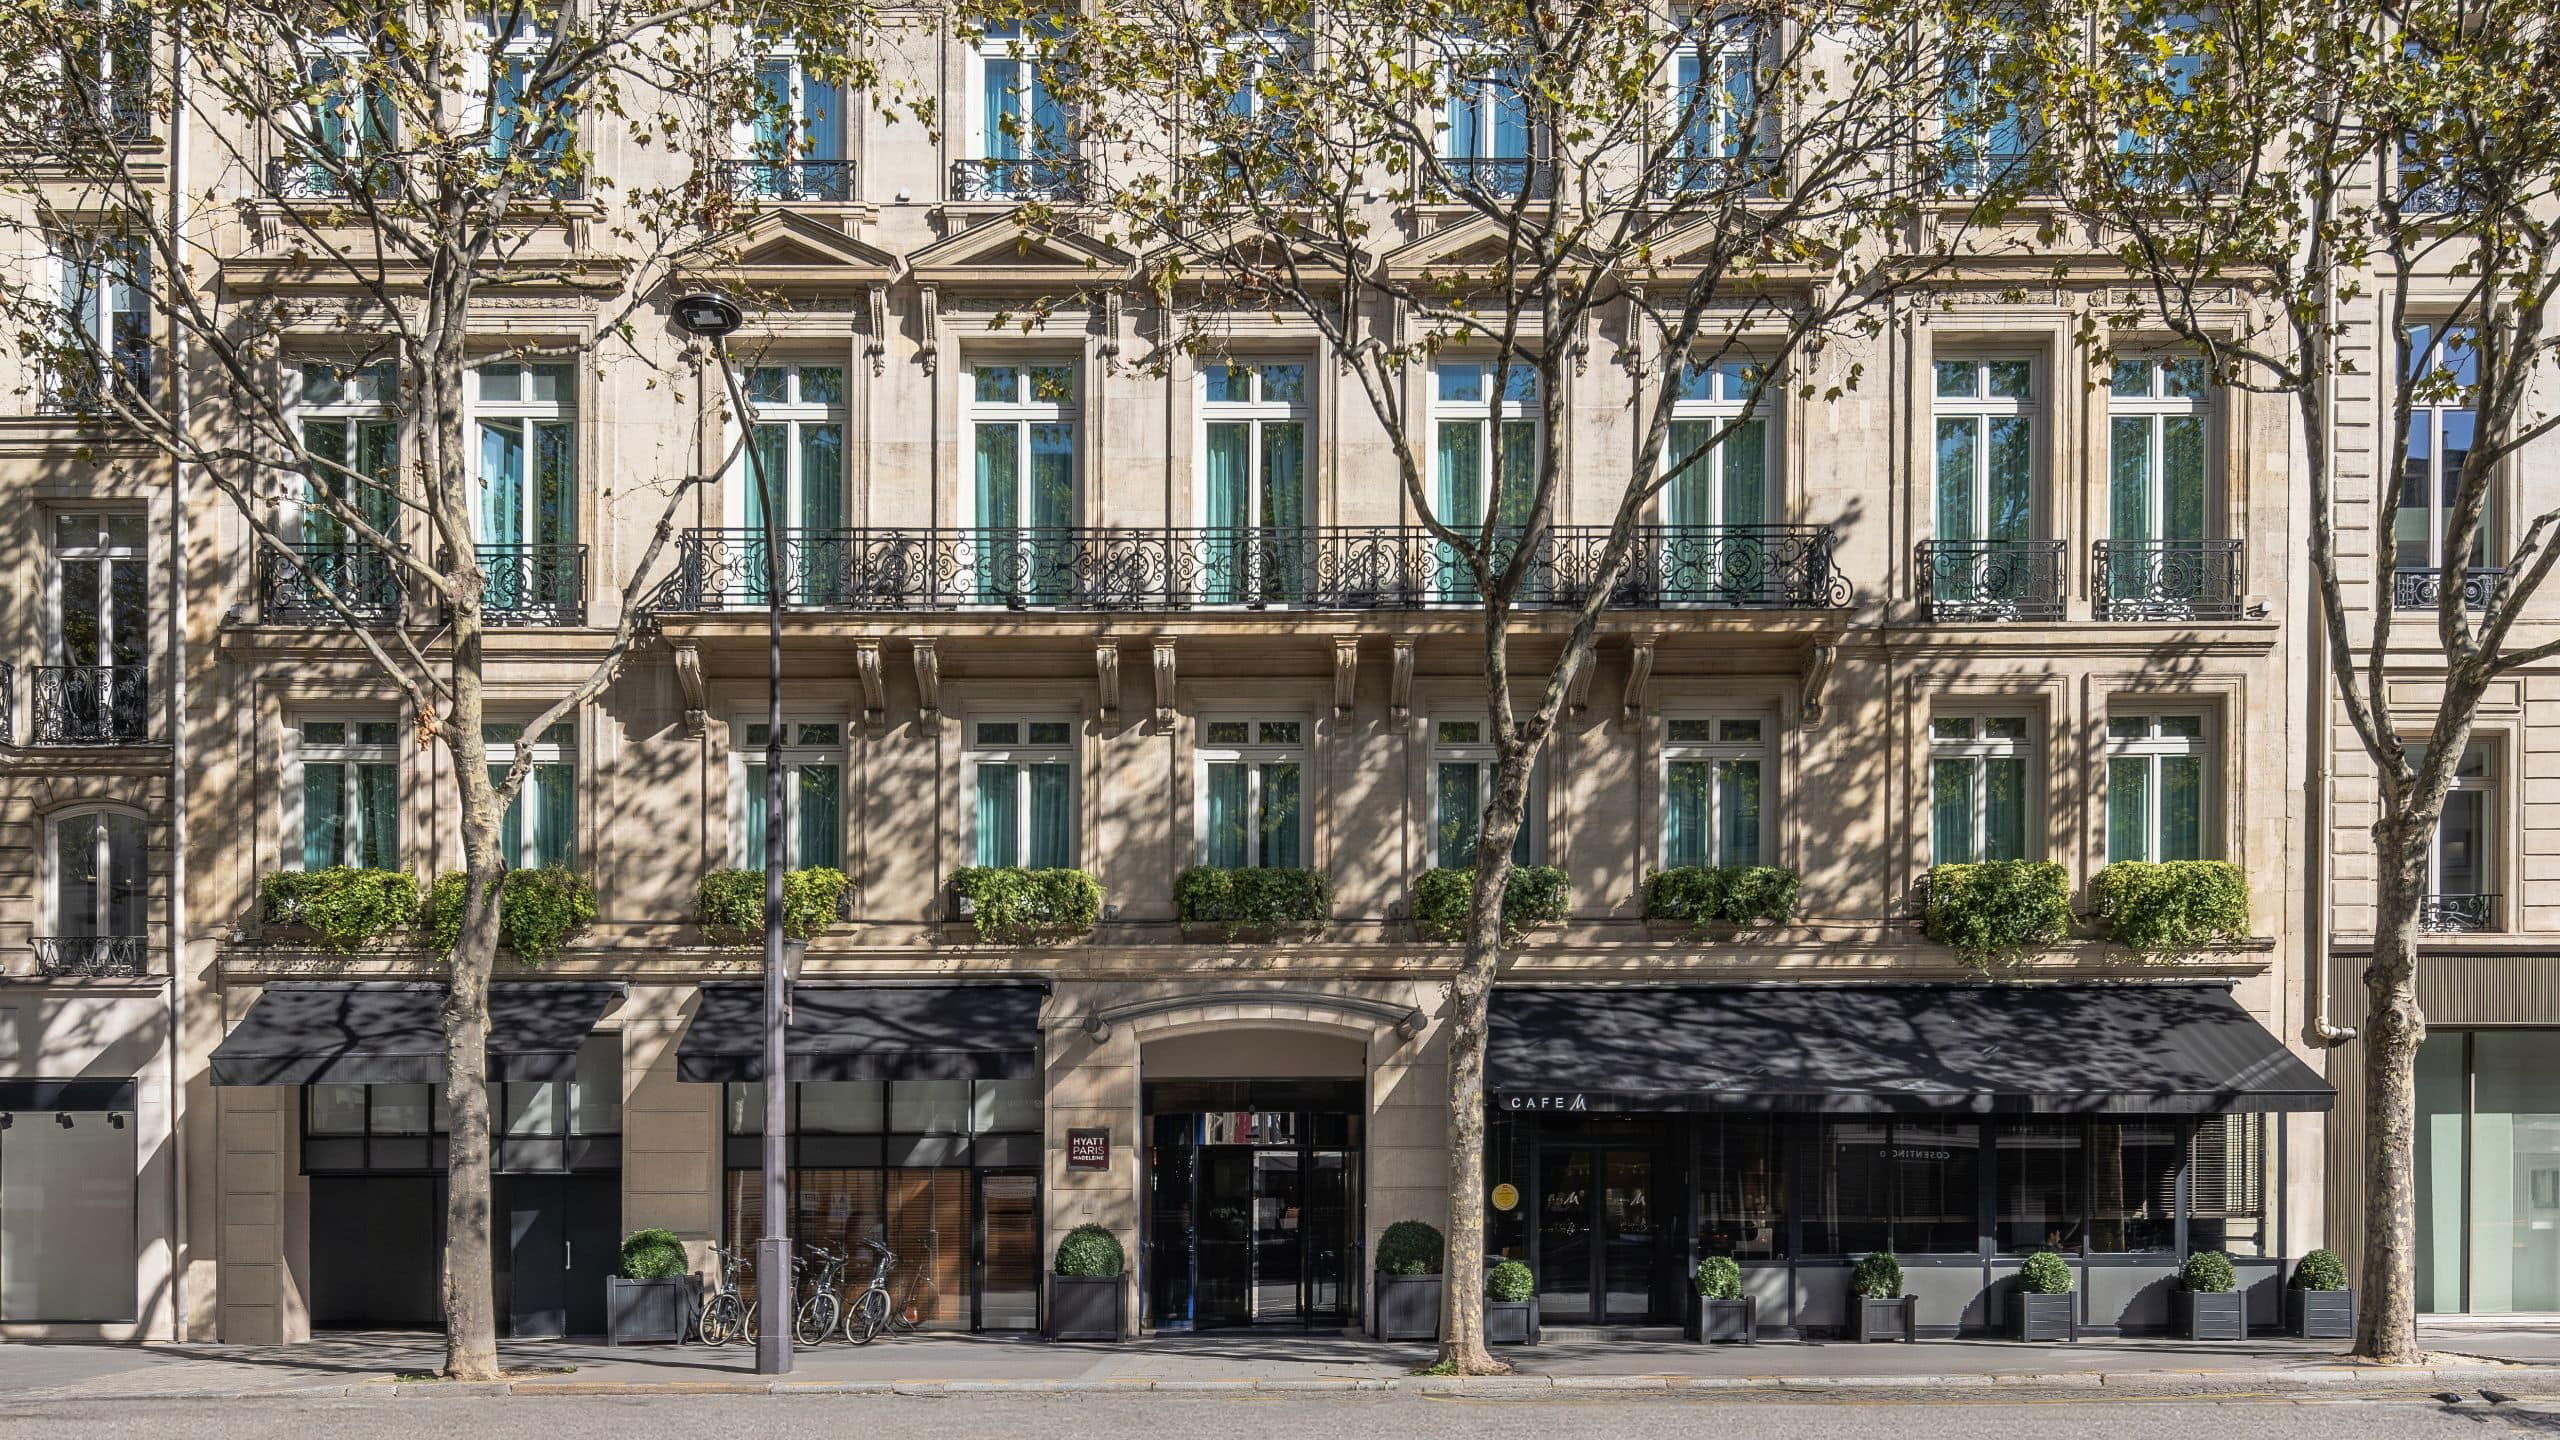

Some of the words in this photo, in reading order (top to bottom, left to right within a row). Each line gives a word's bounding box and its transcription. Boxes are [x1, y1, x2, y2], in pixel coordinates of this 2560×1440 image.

[1511, 1097, 1564, 1109] CAFE
[1569, 1093, 1587, 1111] M
[1073, 1137, 1105, 1146] HYATT
[1073, 1146, 1105, 1155] PARIS
